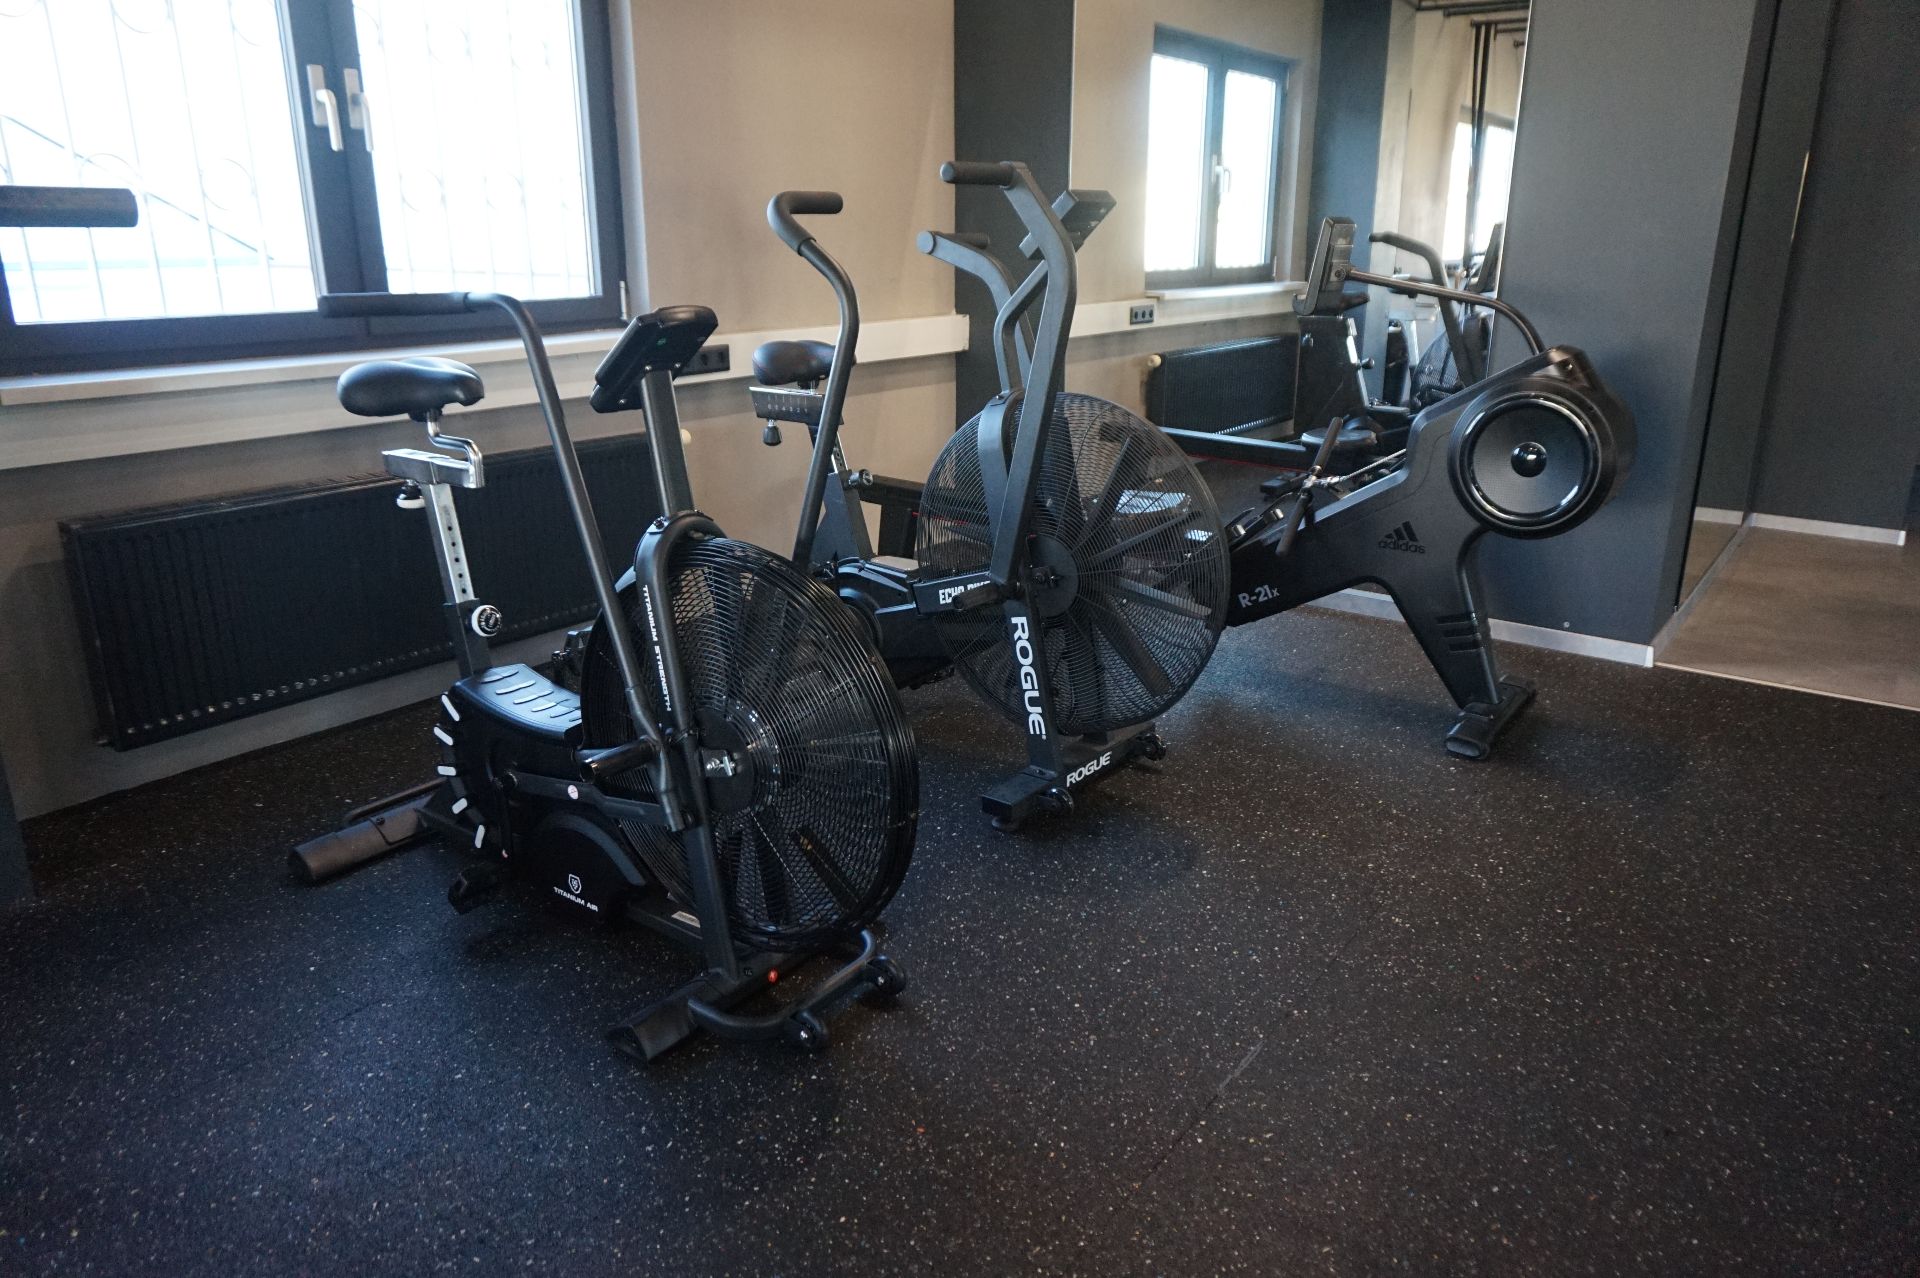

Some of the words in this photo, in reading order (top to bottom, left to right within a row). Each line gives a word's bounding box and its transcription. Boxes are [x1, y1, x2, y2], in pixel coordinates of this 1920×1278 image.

[1378, 539, 1426, 554] adidas
[642, 584, 658, 641] TITANIUM
[654, 645, 671, 711] STRENGTH
[1010, 616, 1046, 735] ROGUE
[1066, 750, 1113, 788] ROGUE
[553, 886, 585, 906] TITANIUM
[586, 902, 599, 912] AIR
